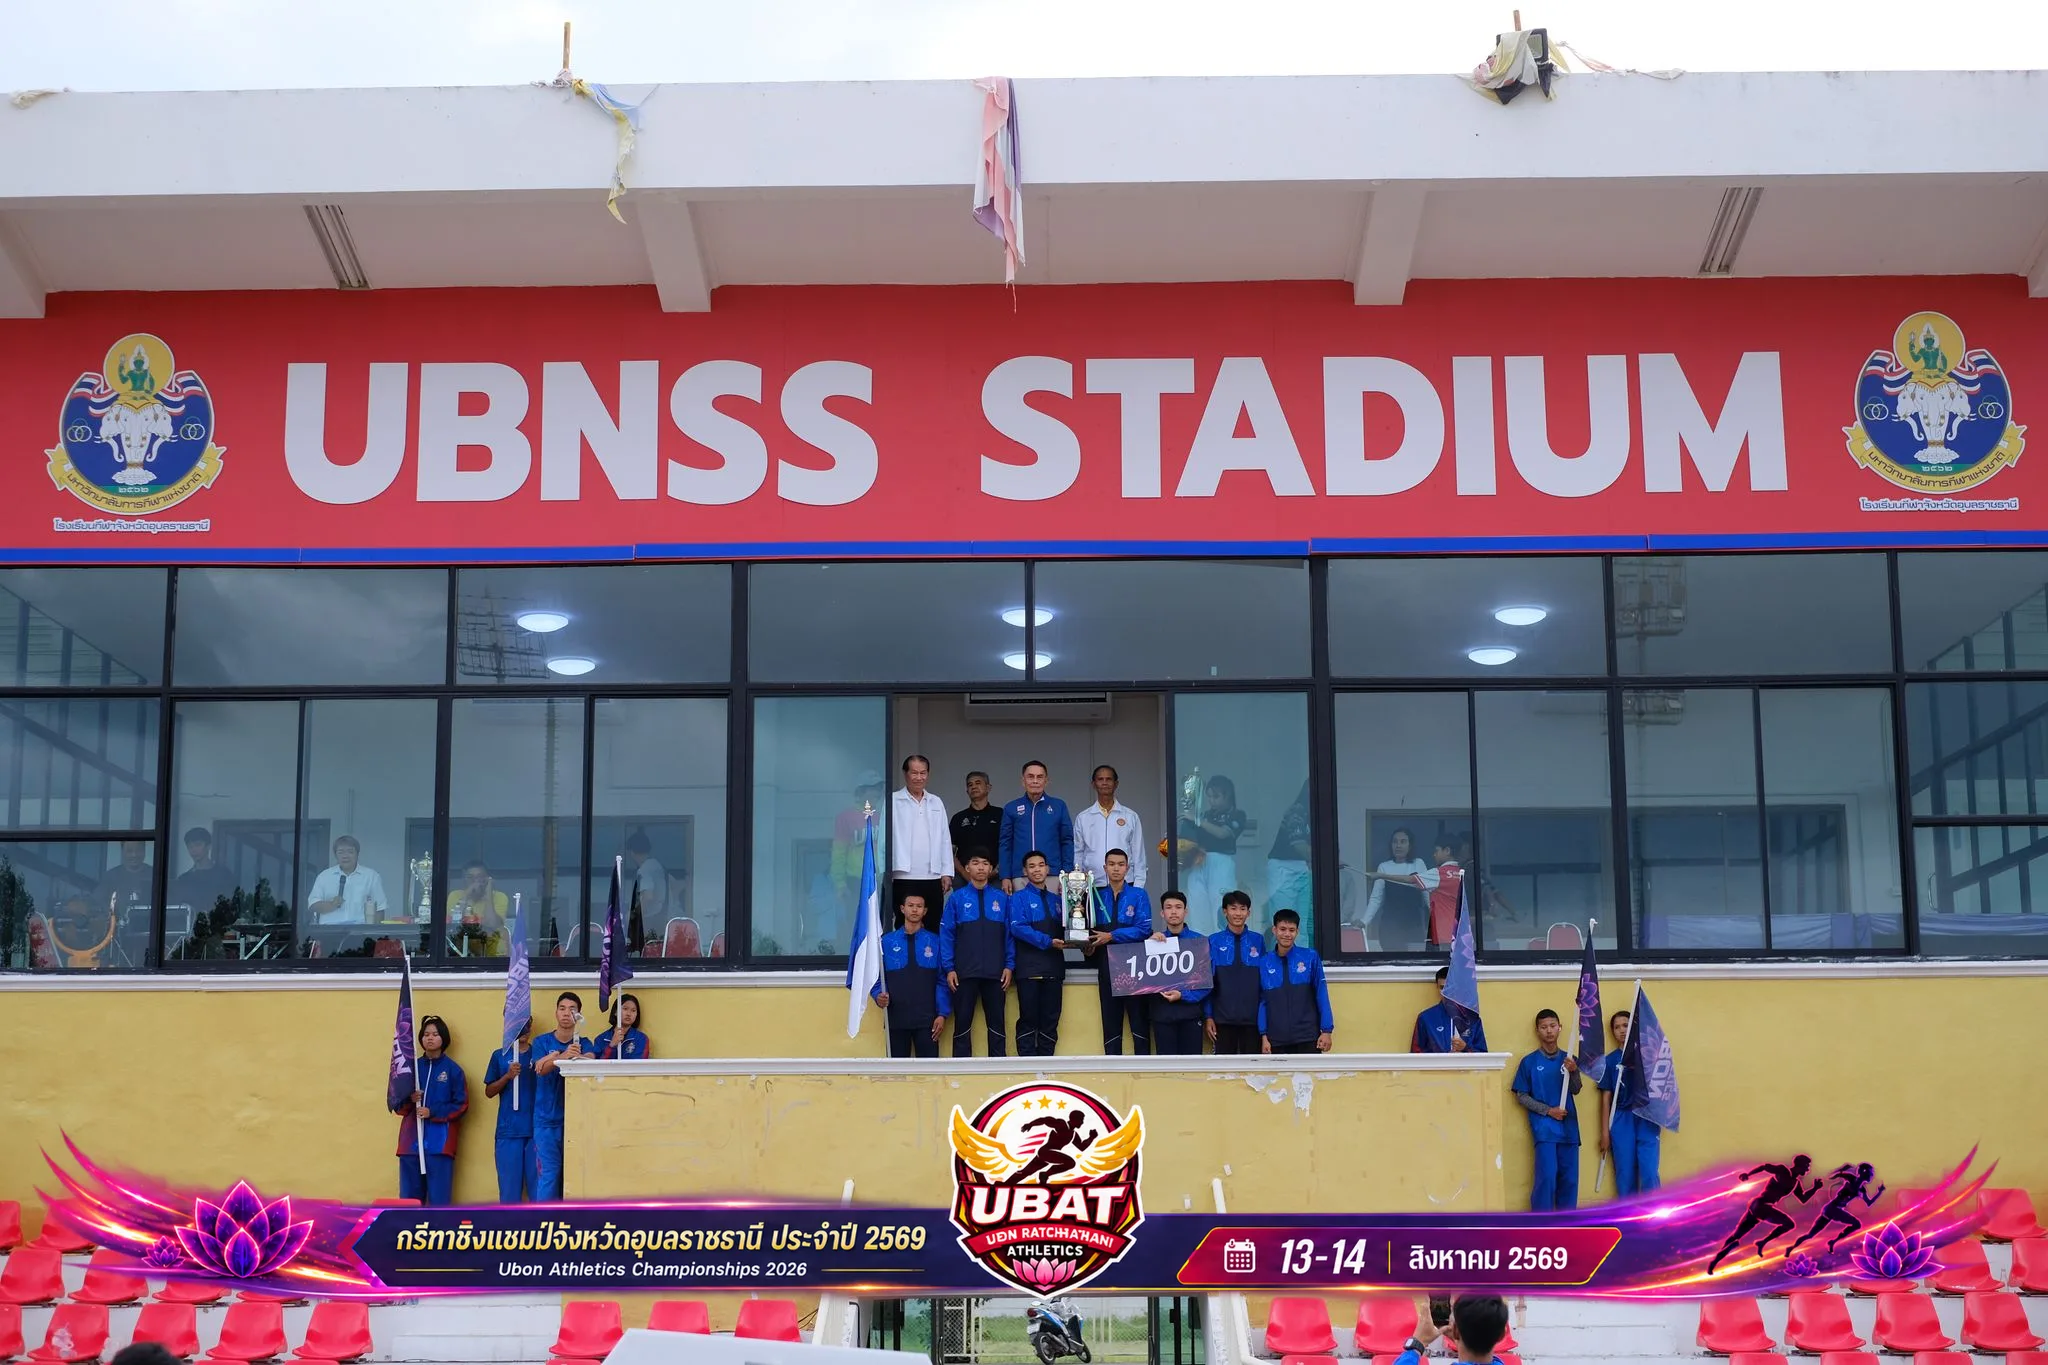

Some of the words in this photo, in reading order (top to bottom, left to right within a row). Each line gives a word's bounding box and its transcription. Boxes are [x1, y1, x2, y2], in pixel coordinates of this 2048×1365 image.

[285, 360, 878, 505] UBNSS
[981, 352, 1788, 500] STADIUM
[1126, 950, 1195, 980] 1,000
